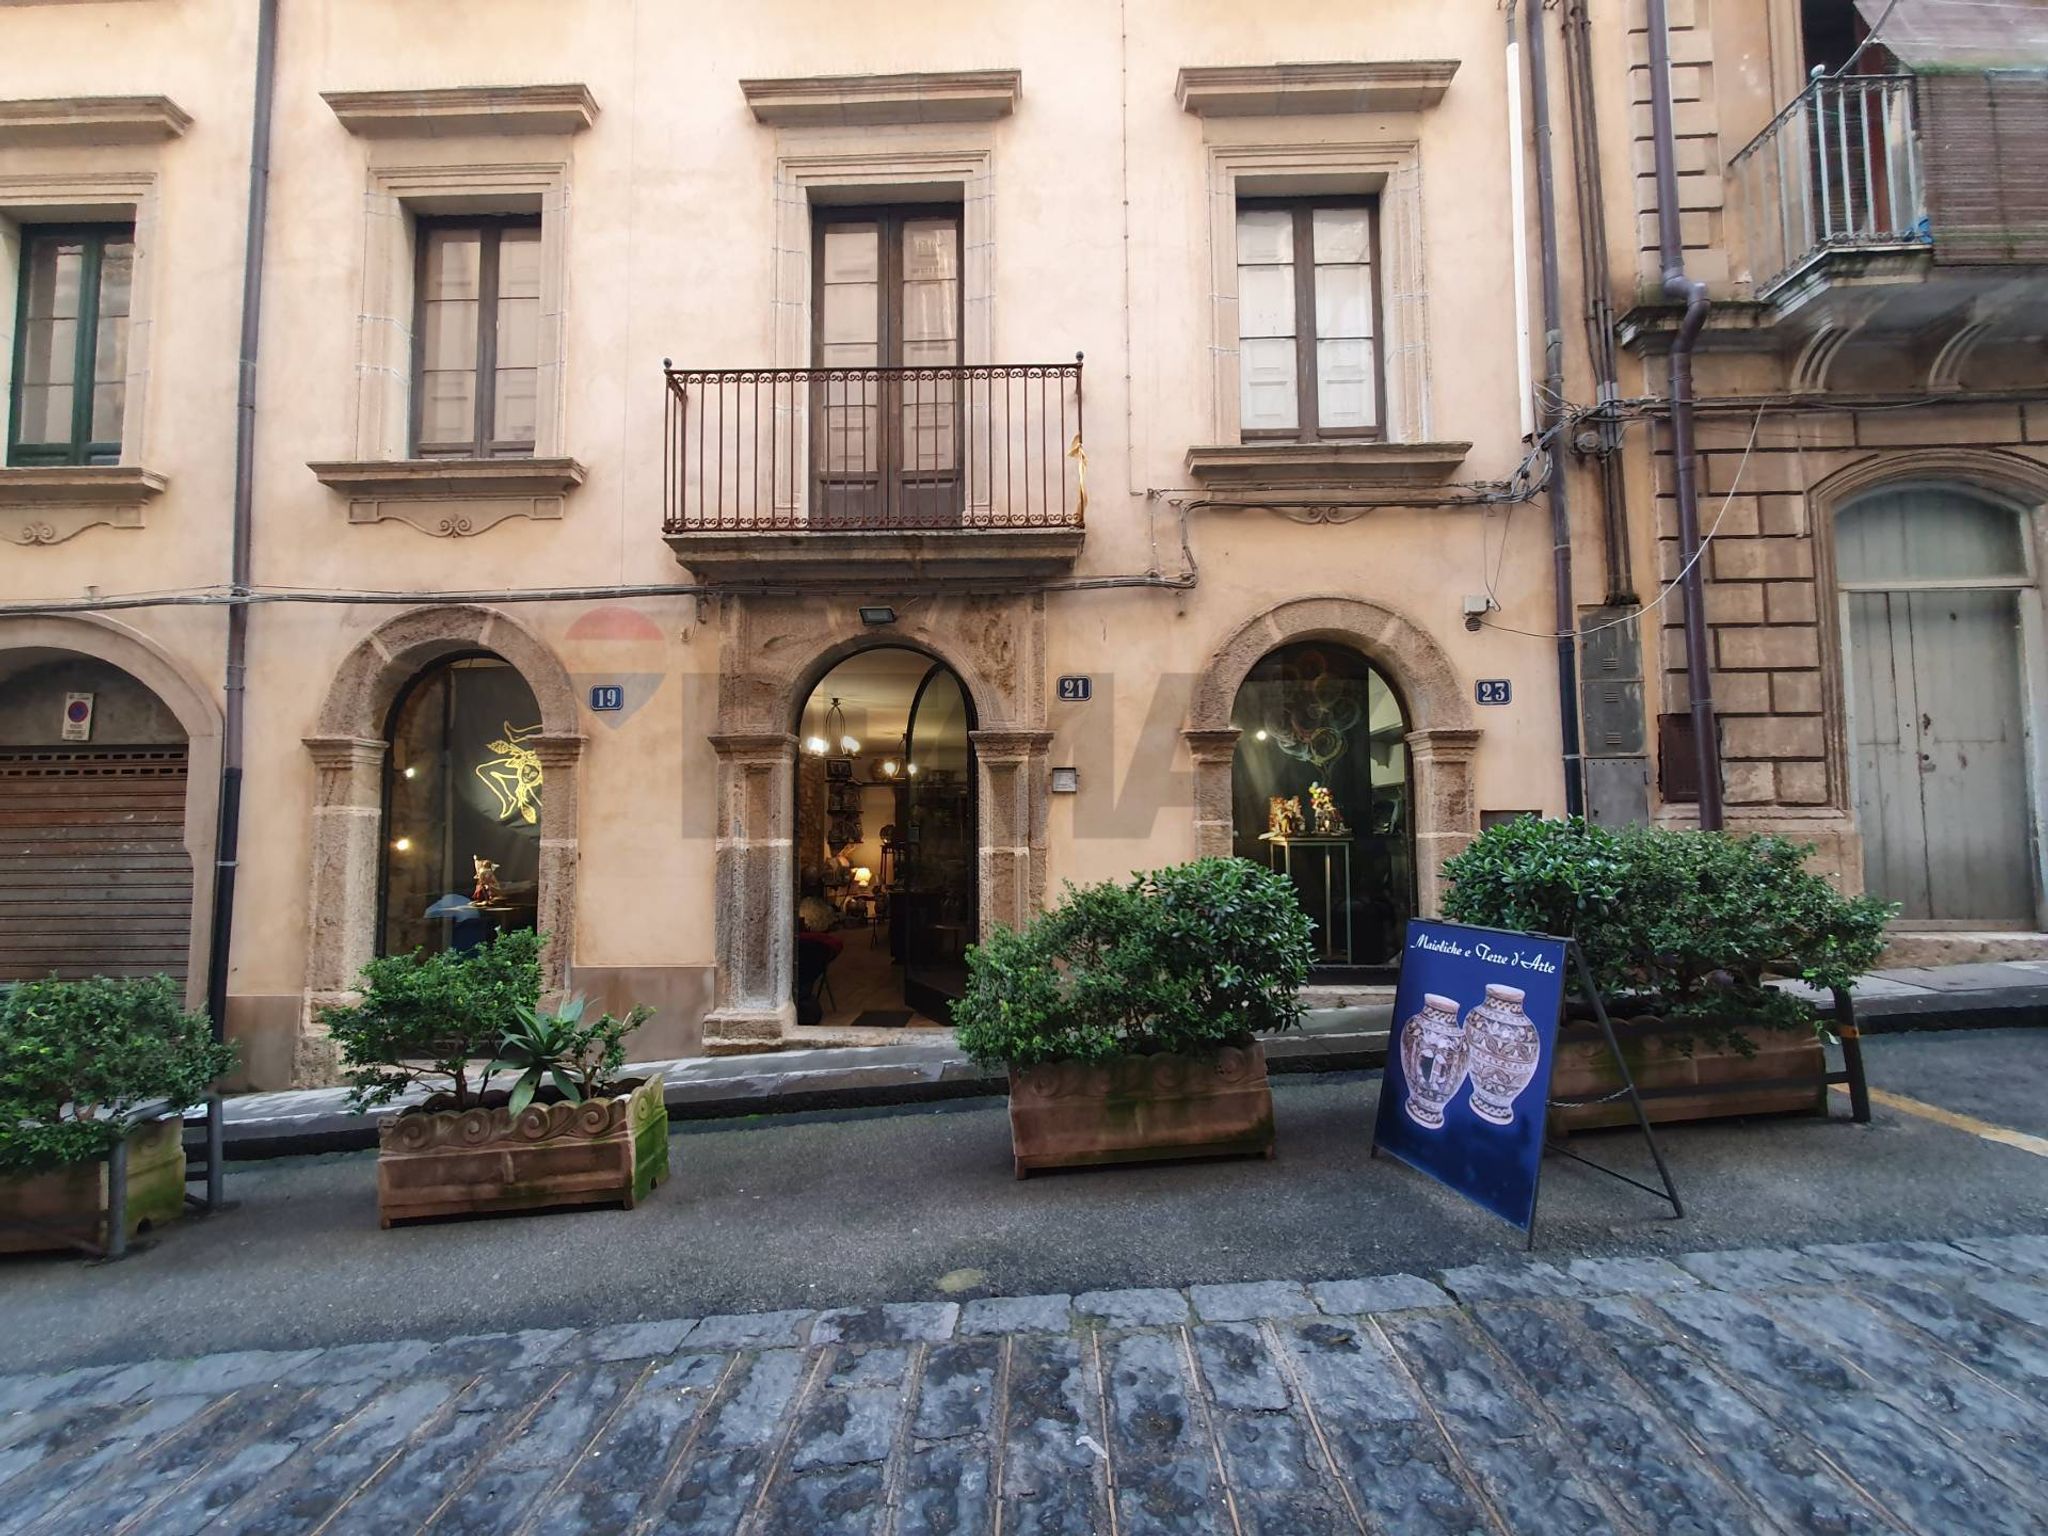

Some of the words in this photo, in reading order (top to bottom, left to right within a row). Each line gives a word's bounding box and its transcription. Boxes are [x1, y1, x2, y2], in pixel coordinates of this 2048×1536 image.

[1064, 679, 1084, 697] 21
[1481, 682, 1505, 701] 23
[598, 689, 617, 707] 19
[1410, 933, 1462, 956] Maioliche
[1464, 949, 1472, 957] e
[1475, 943, 1509, 965] Terre
